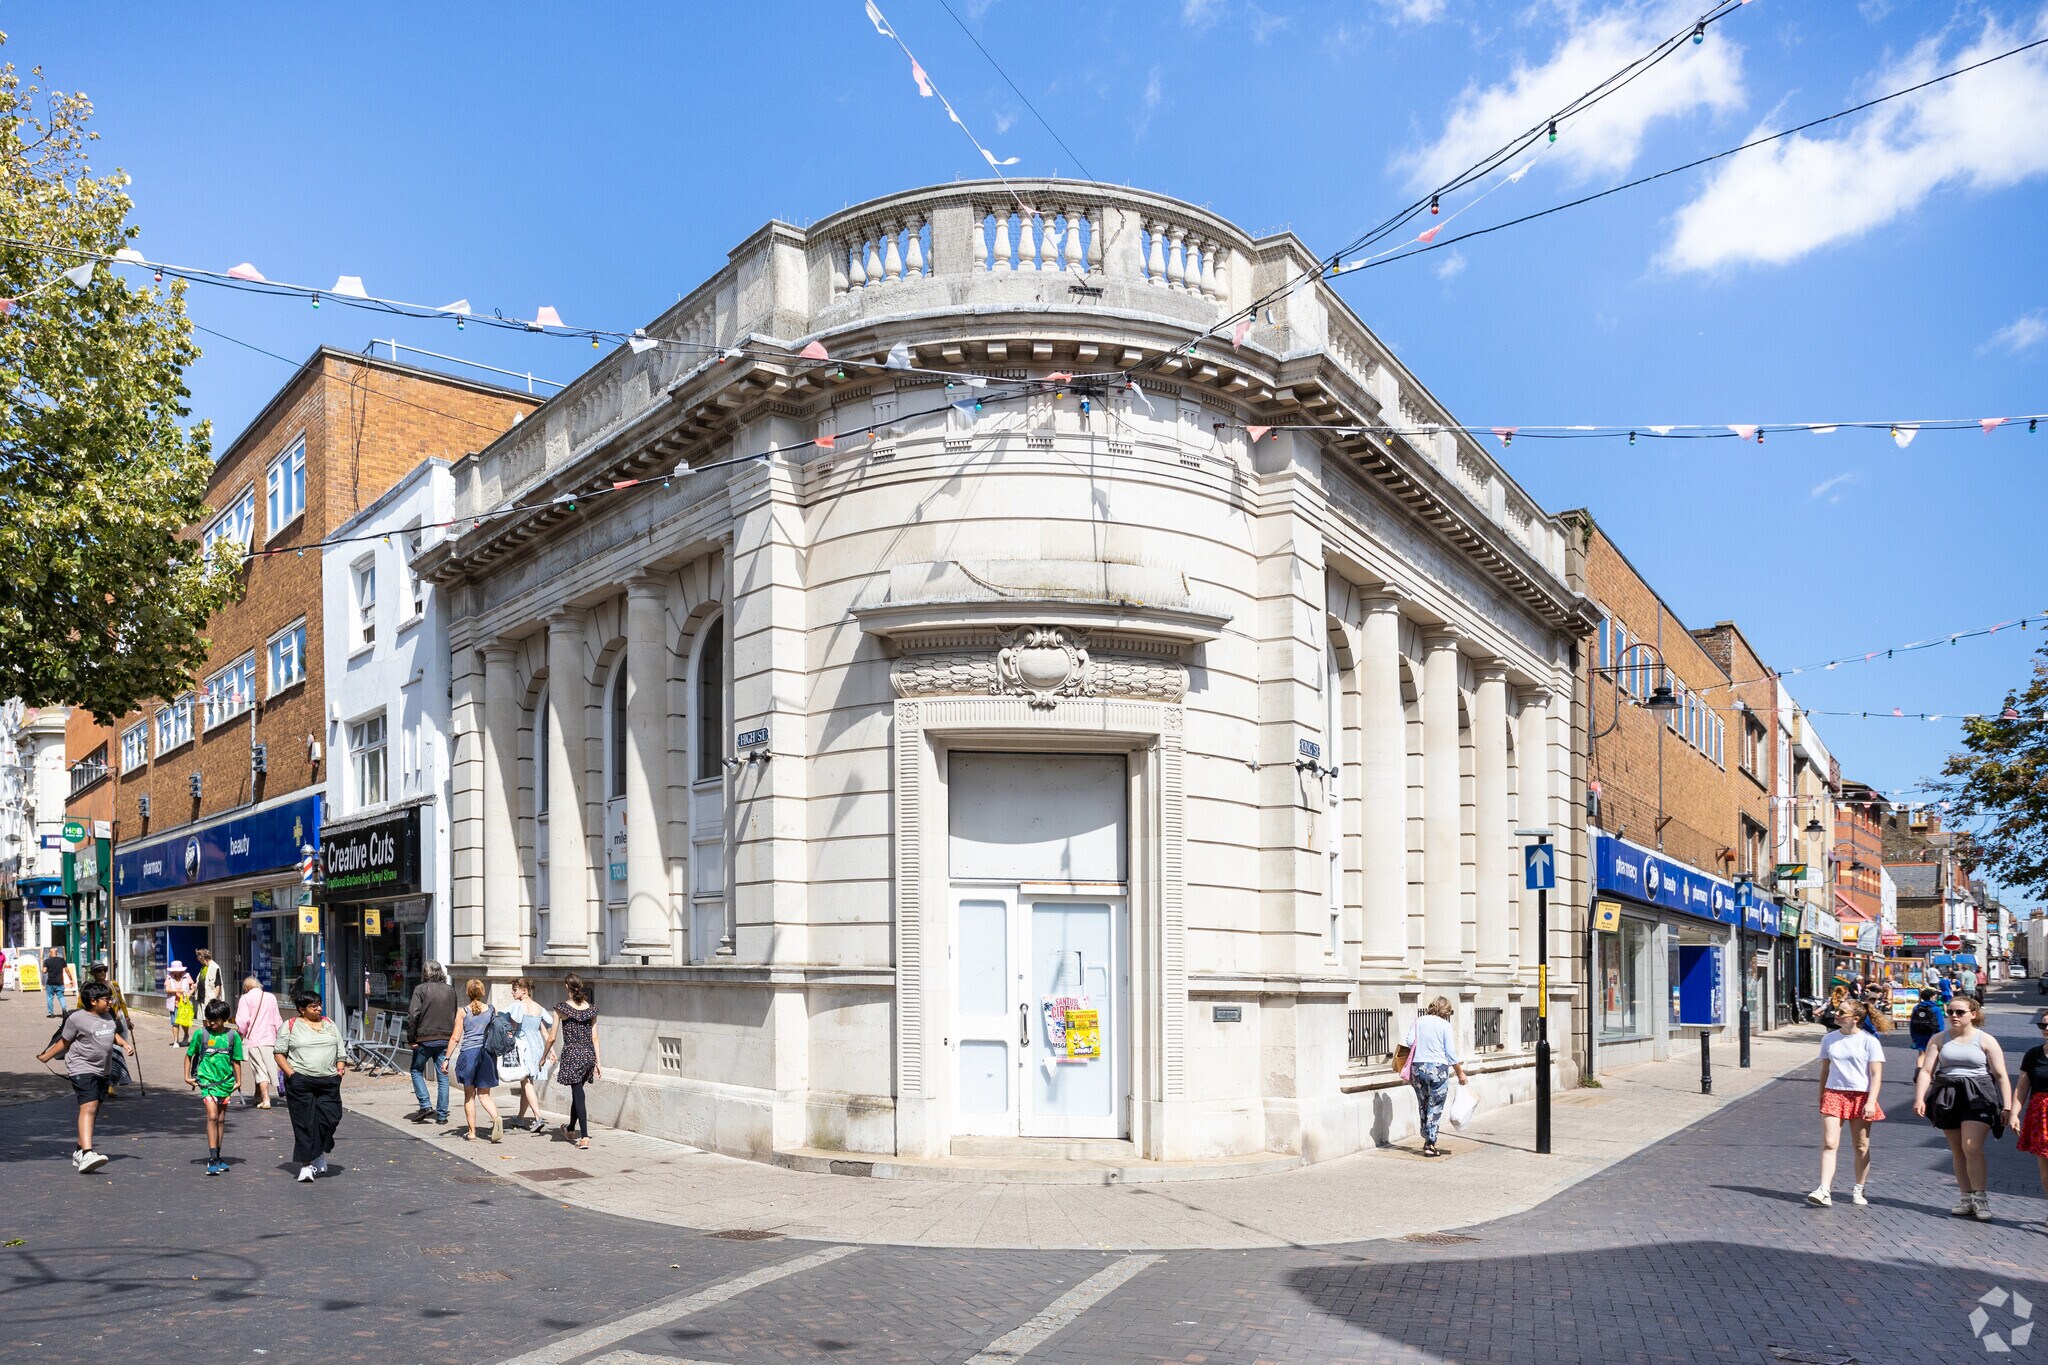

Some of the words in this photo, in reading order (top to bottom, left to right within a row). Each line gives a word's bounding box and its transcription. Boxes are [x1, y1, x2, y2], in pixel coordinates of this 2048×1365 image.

[740, 732, 755, 745] HIGH
[1301, 741, 1312, 754] KING
[230, 834, 250, 856] beauty
[328, 837, 367, 873] Creative
[369, 831, 395, 866] Cuts
[143, 860, 162, 879] pharmacy
[612, 866, 621, 878] TO
[1616, 855, 1637, 883] pharmacy
[49, 885, 58, 893] 17
[1664, 873, 1676, 896] beauty
[1693, 884, 1707, 906] pharmacy
